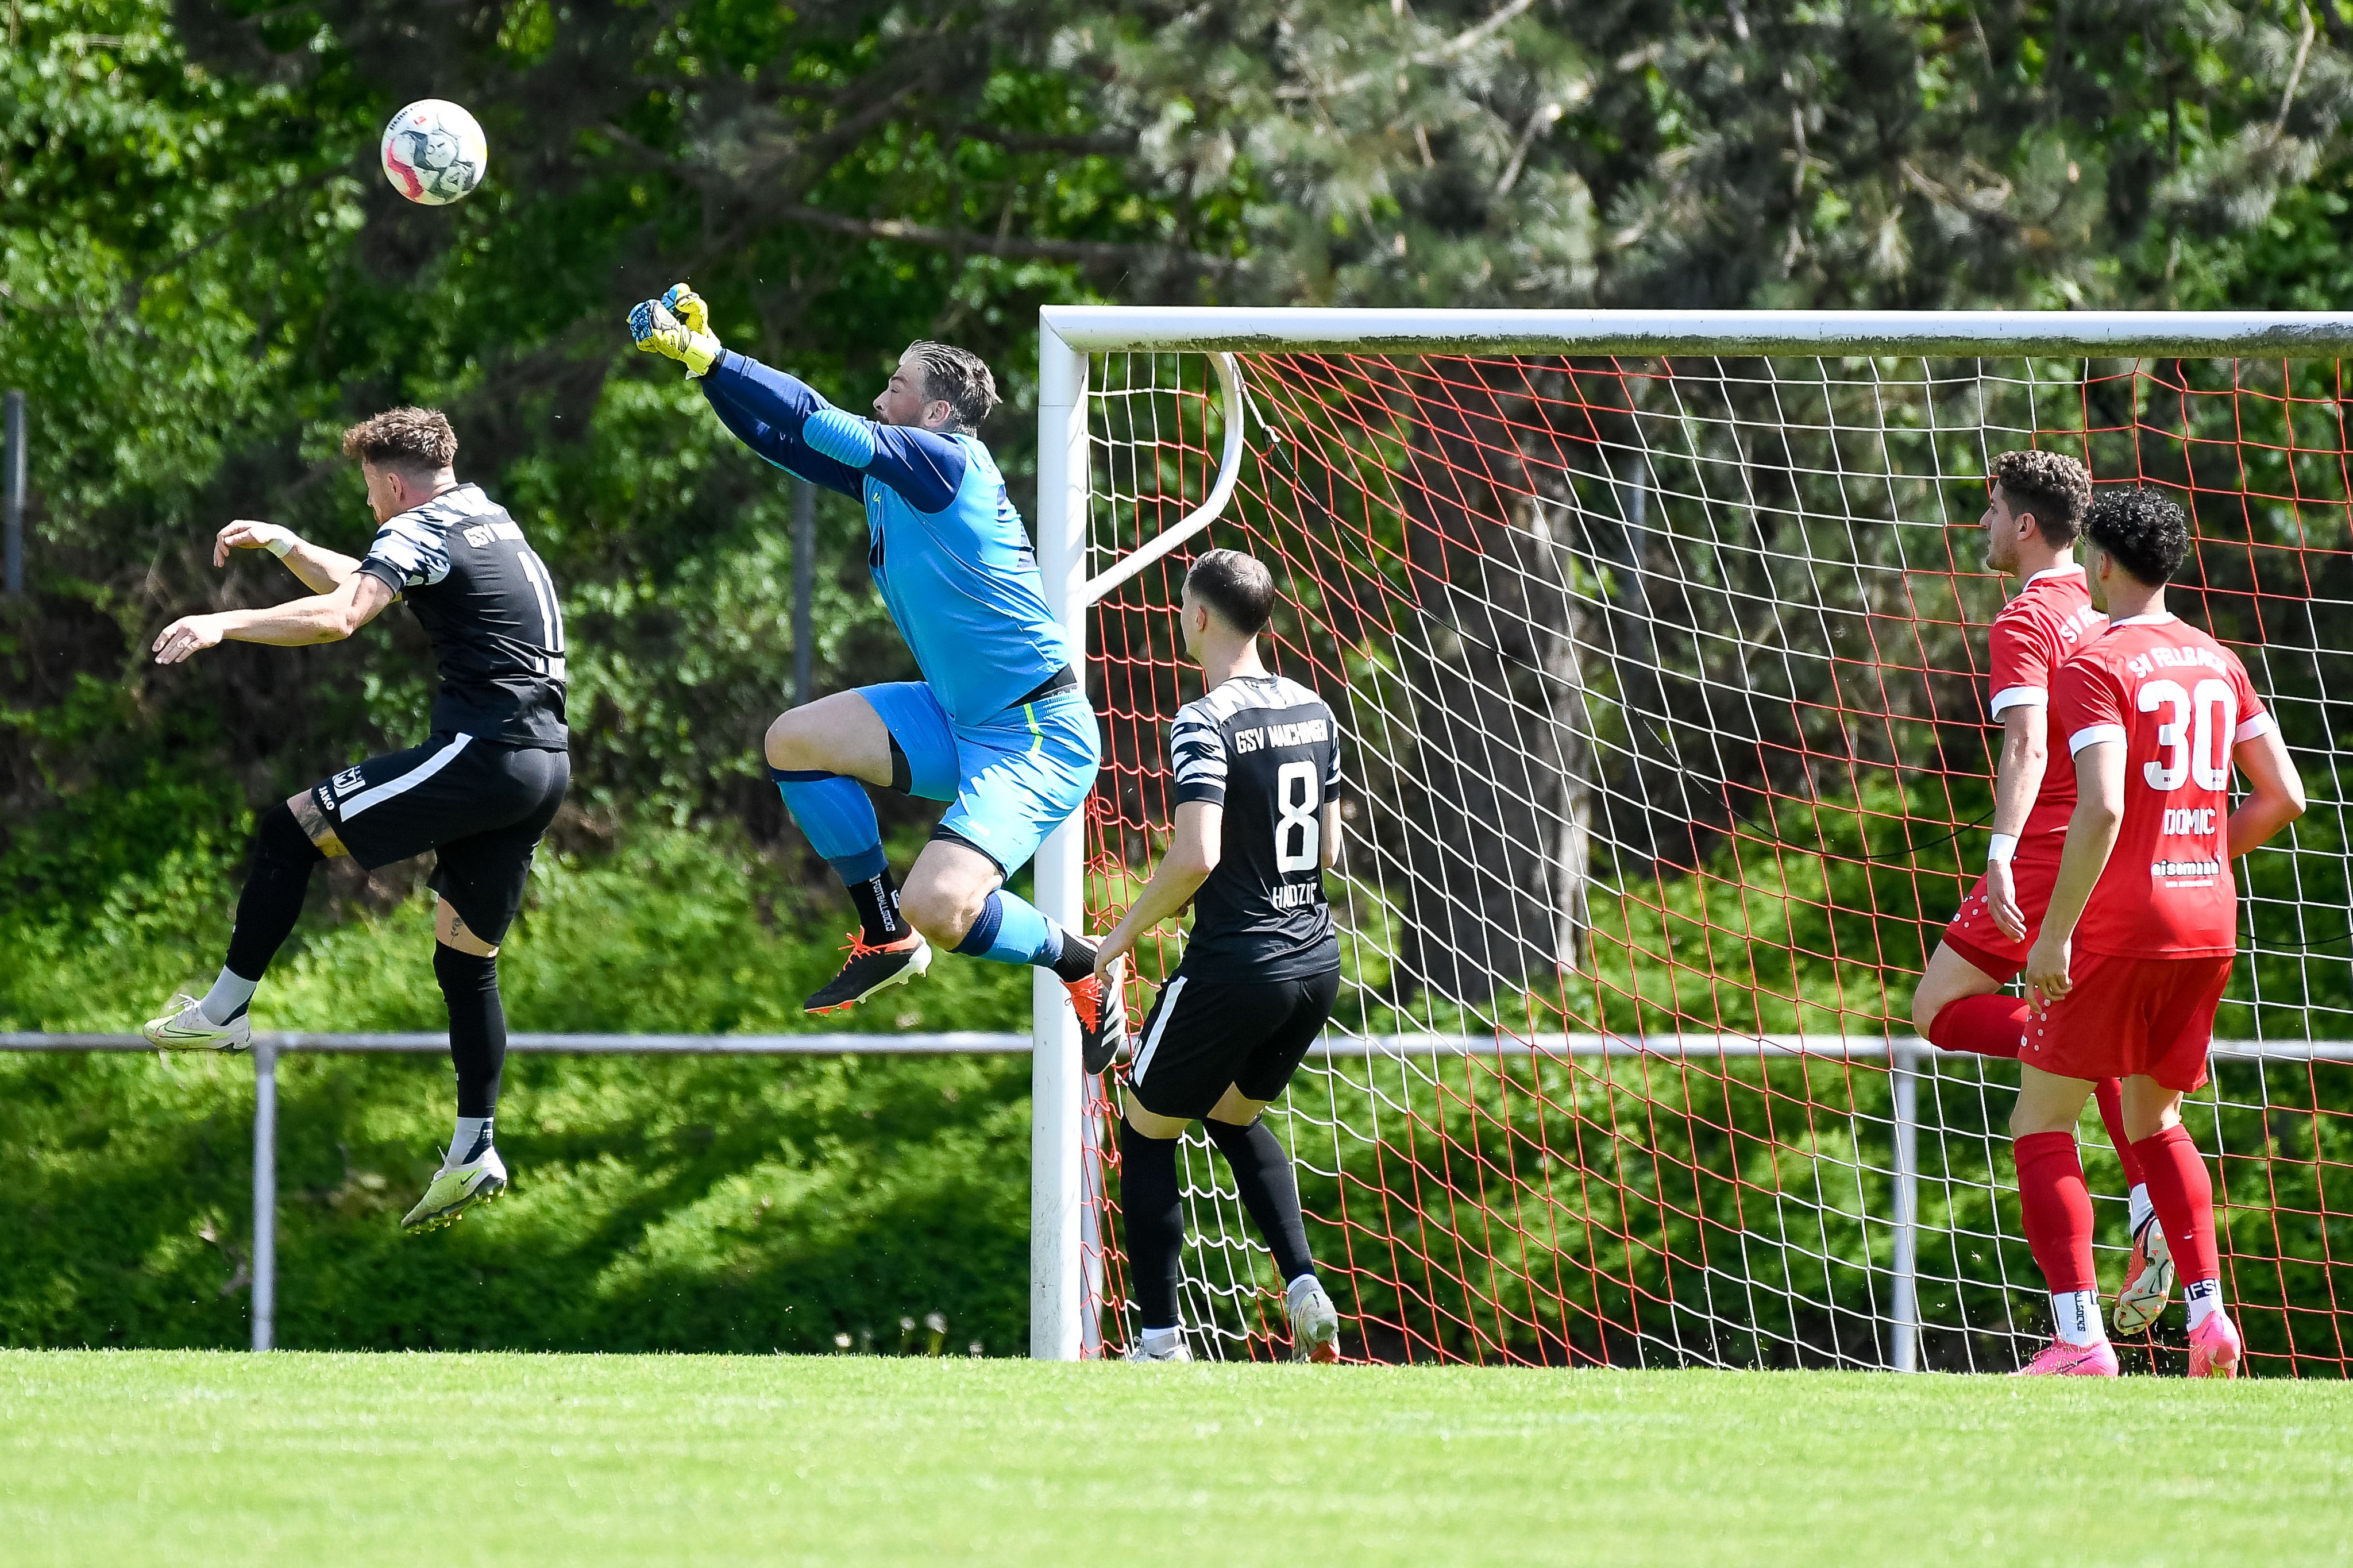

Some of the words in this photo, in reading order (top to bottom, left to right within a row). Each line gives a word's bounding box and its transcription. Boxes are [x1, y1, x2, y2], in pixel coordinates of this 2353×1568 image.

[2060, 615, 2083, 644] SV
[2128, 653, 2154, 678] SV
[1235, 727, 1264, 754] GSV
[2137, 679, 2238, 791] 30
[318, 786, 335, 810] JAKO
[1275, 760, 1320, 874] 8
[2163, 808, 2216, 836] DOMIC
[2152, 860, 2220, 876] eisemann
[872, 879, 896, 932] FOOTBALLSOCKS
[2190, 1279, 2216, 1299] FS
